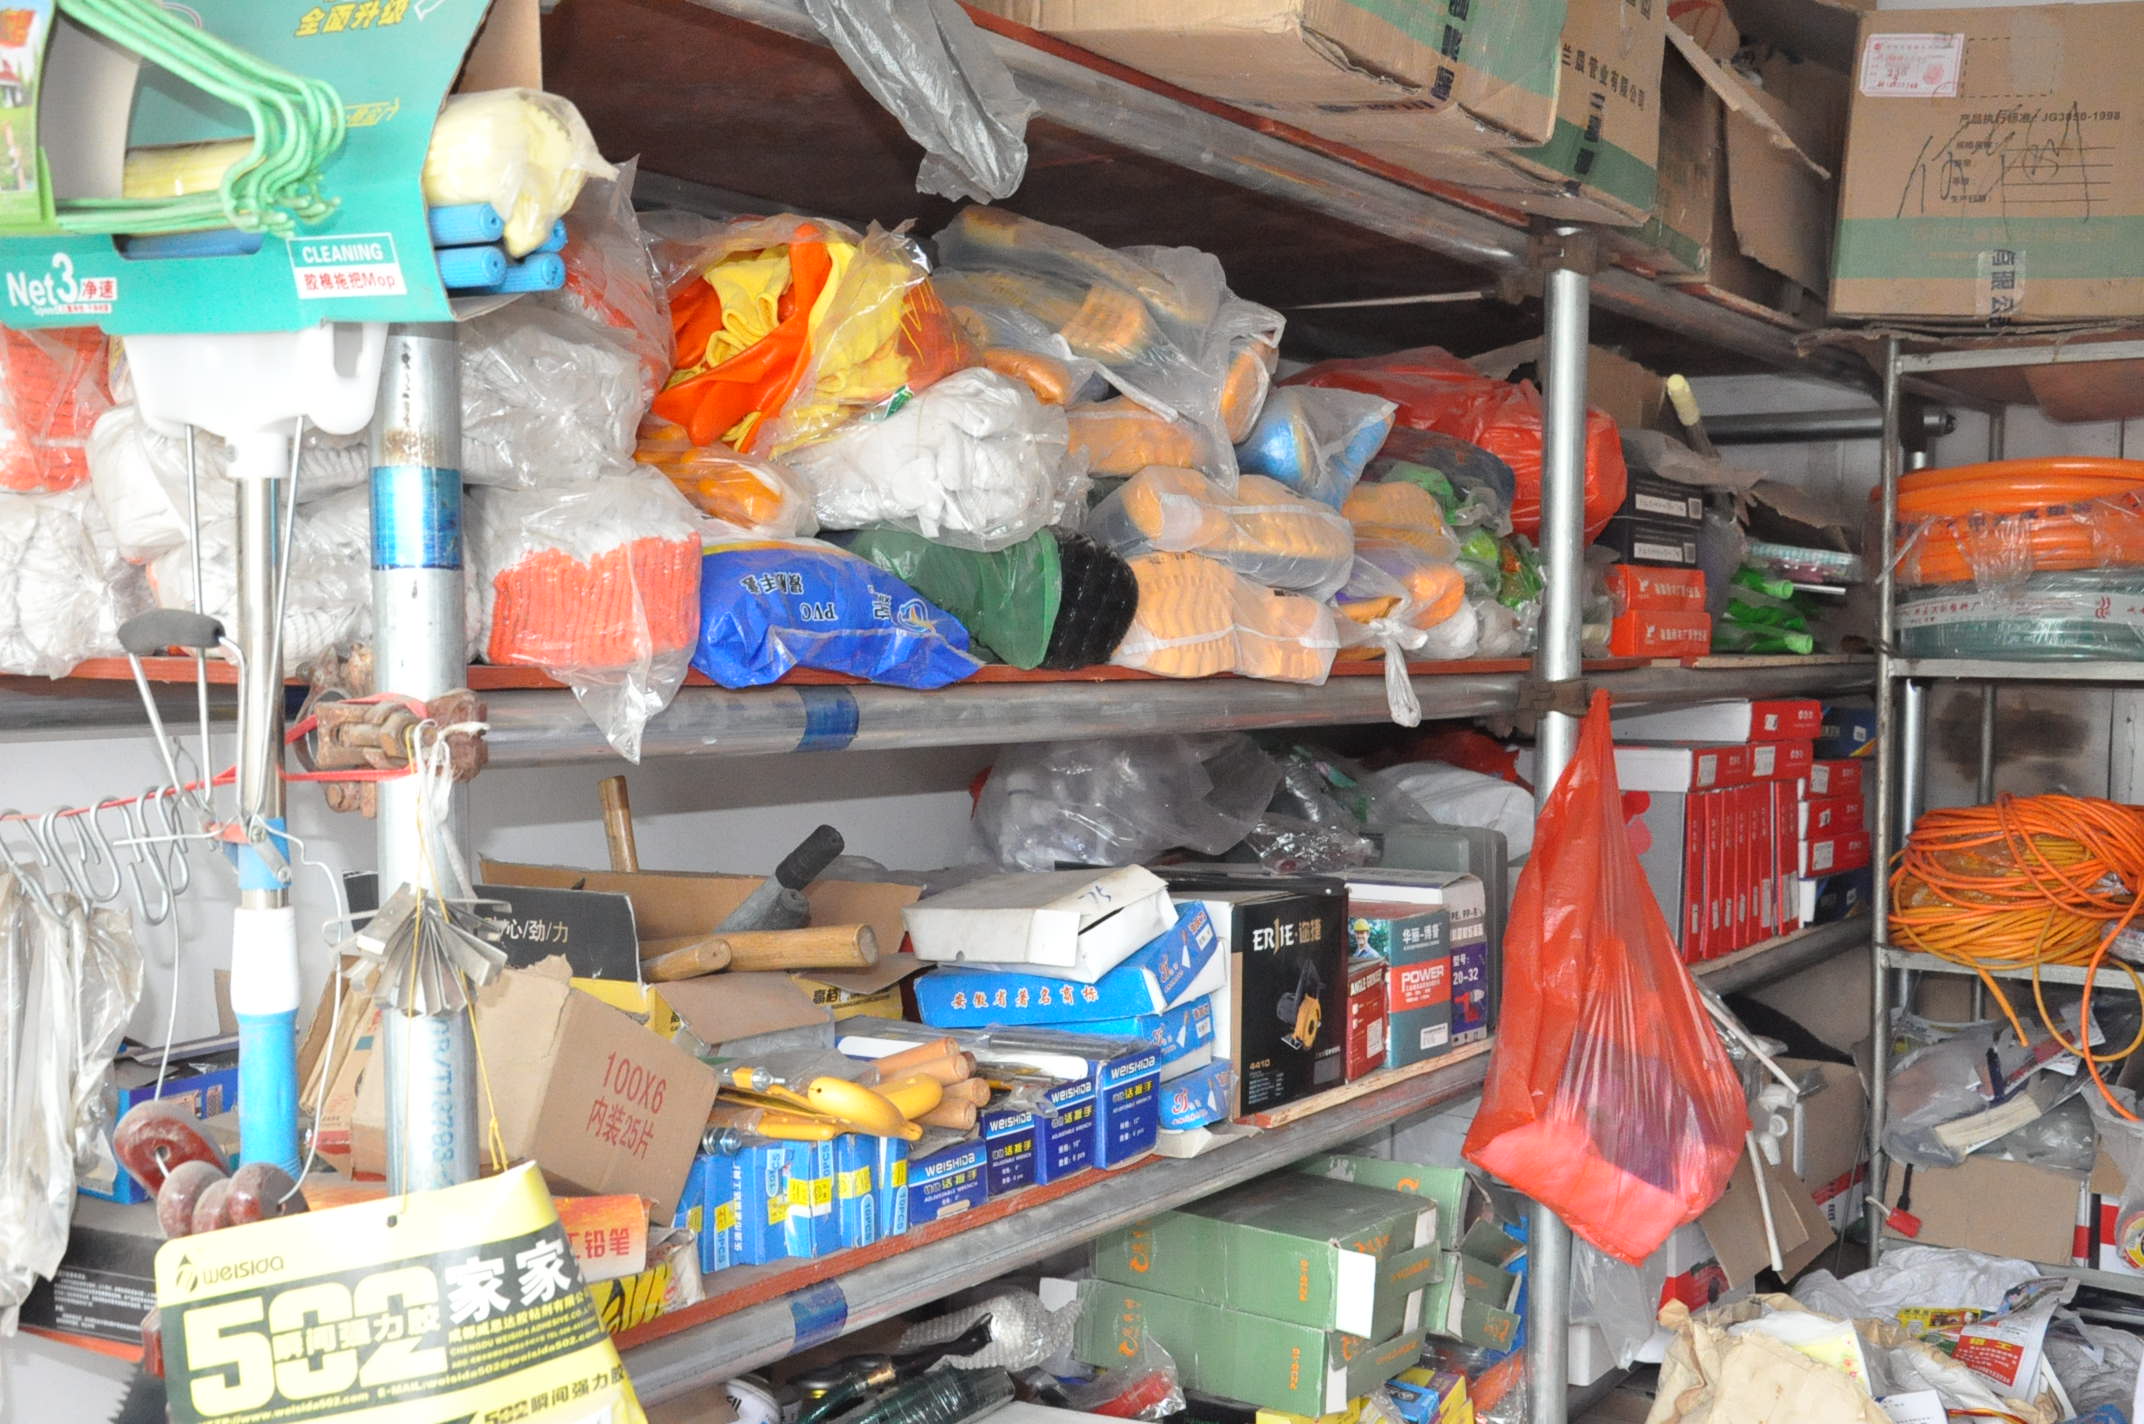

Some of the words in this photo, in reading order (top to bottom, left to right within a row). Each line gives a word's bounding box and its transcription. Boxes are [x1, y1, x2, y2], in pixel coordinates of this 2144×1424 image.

[302, 243, 384, 264] CLEANING
[799, 601, 838, 621] PVC
[1252, 918, 1294, 954] ERJIE
[1401, 964, 1444, 993] POWER
[1453, 967, 1479, 986] 20-32
[603, 1051, 667, 1114] 100X6
[586, 1096, 654, 1161] 内装25片
[203, 1255, 285, 1286] weisida
[445, 1239, 586, 1324] 家家
[183, 1265, 448, 1418] 502
